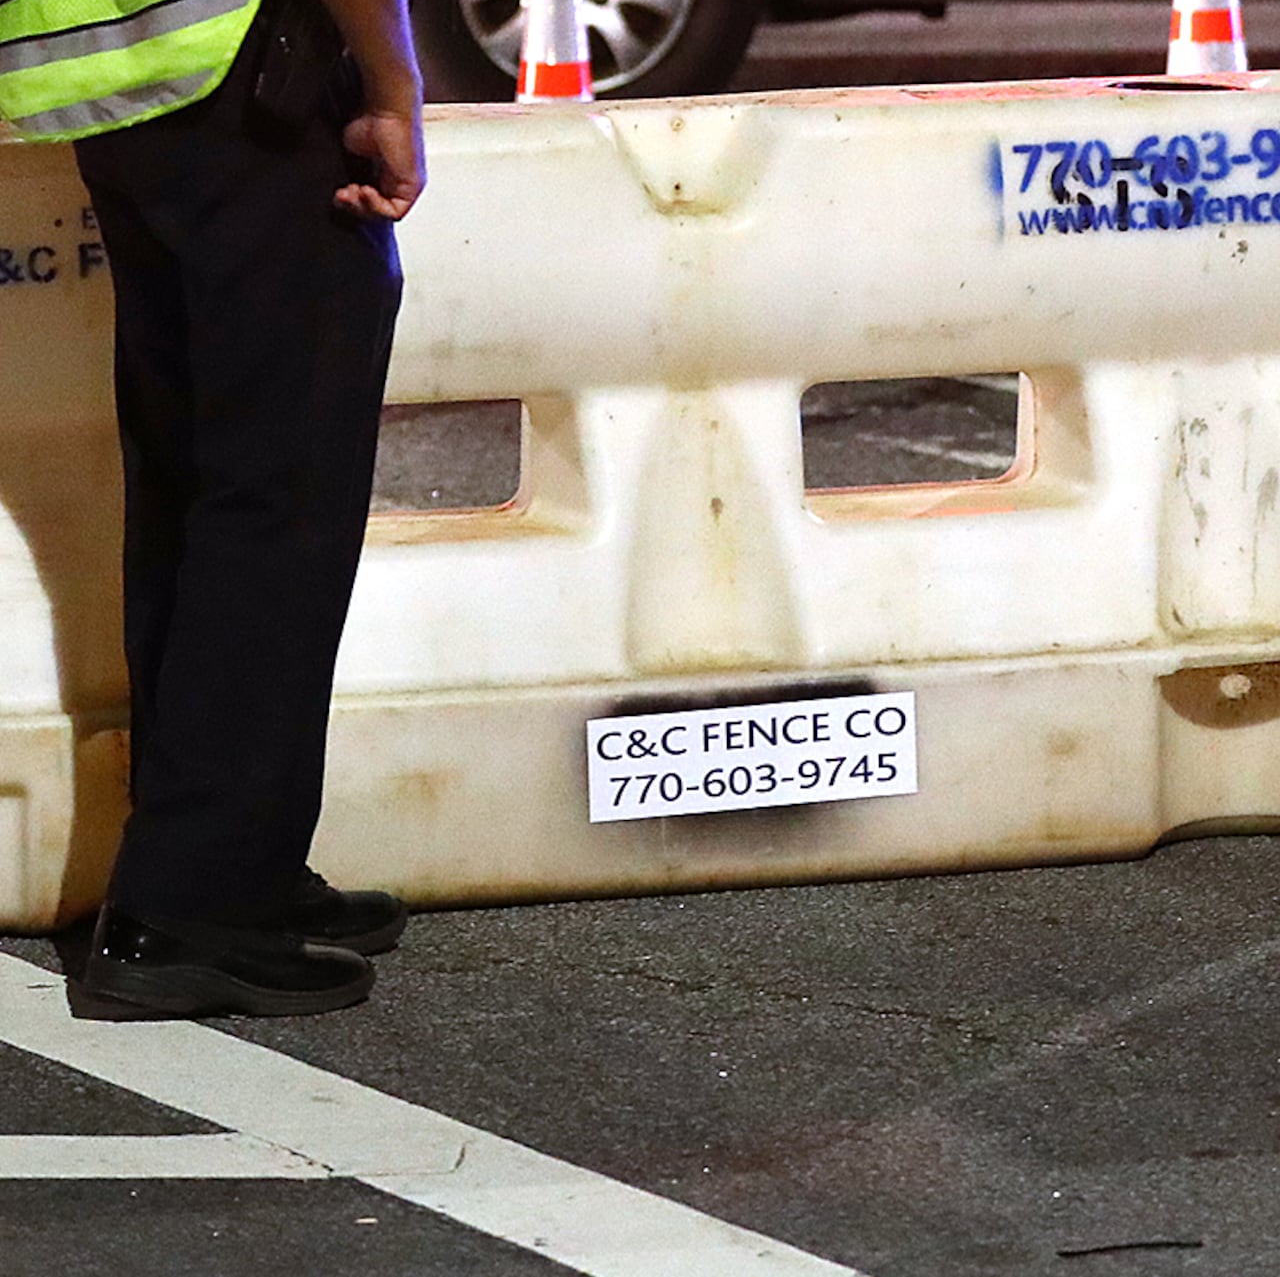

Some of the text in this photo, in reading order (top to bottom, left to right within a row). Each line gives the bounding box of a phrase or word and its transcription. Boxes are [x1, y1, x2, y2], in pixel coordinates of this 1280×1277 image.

[596, 706, 907, 760] C&C FENCE CO
[609, 752, 899, 807] 770-603-9745
